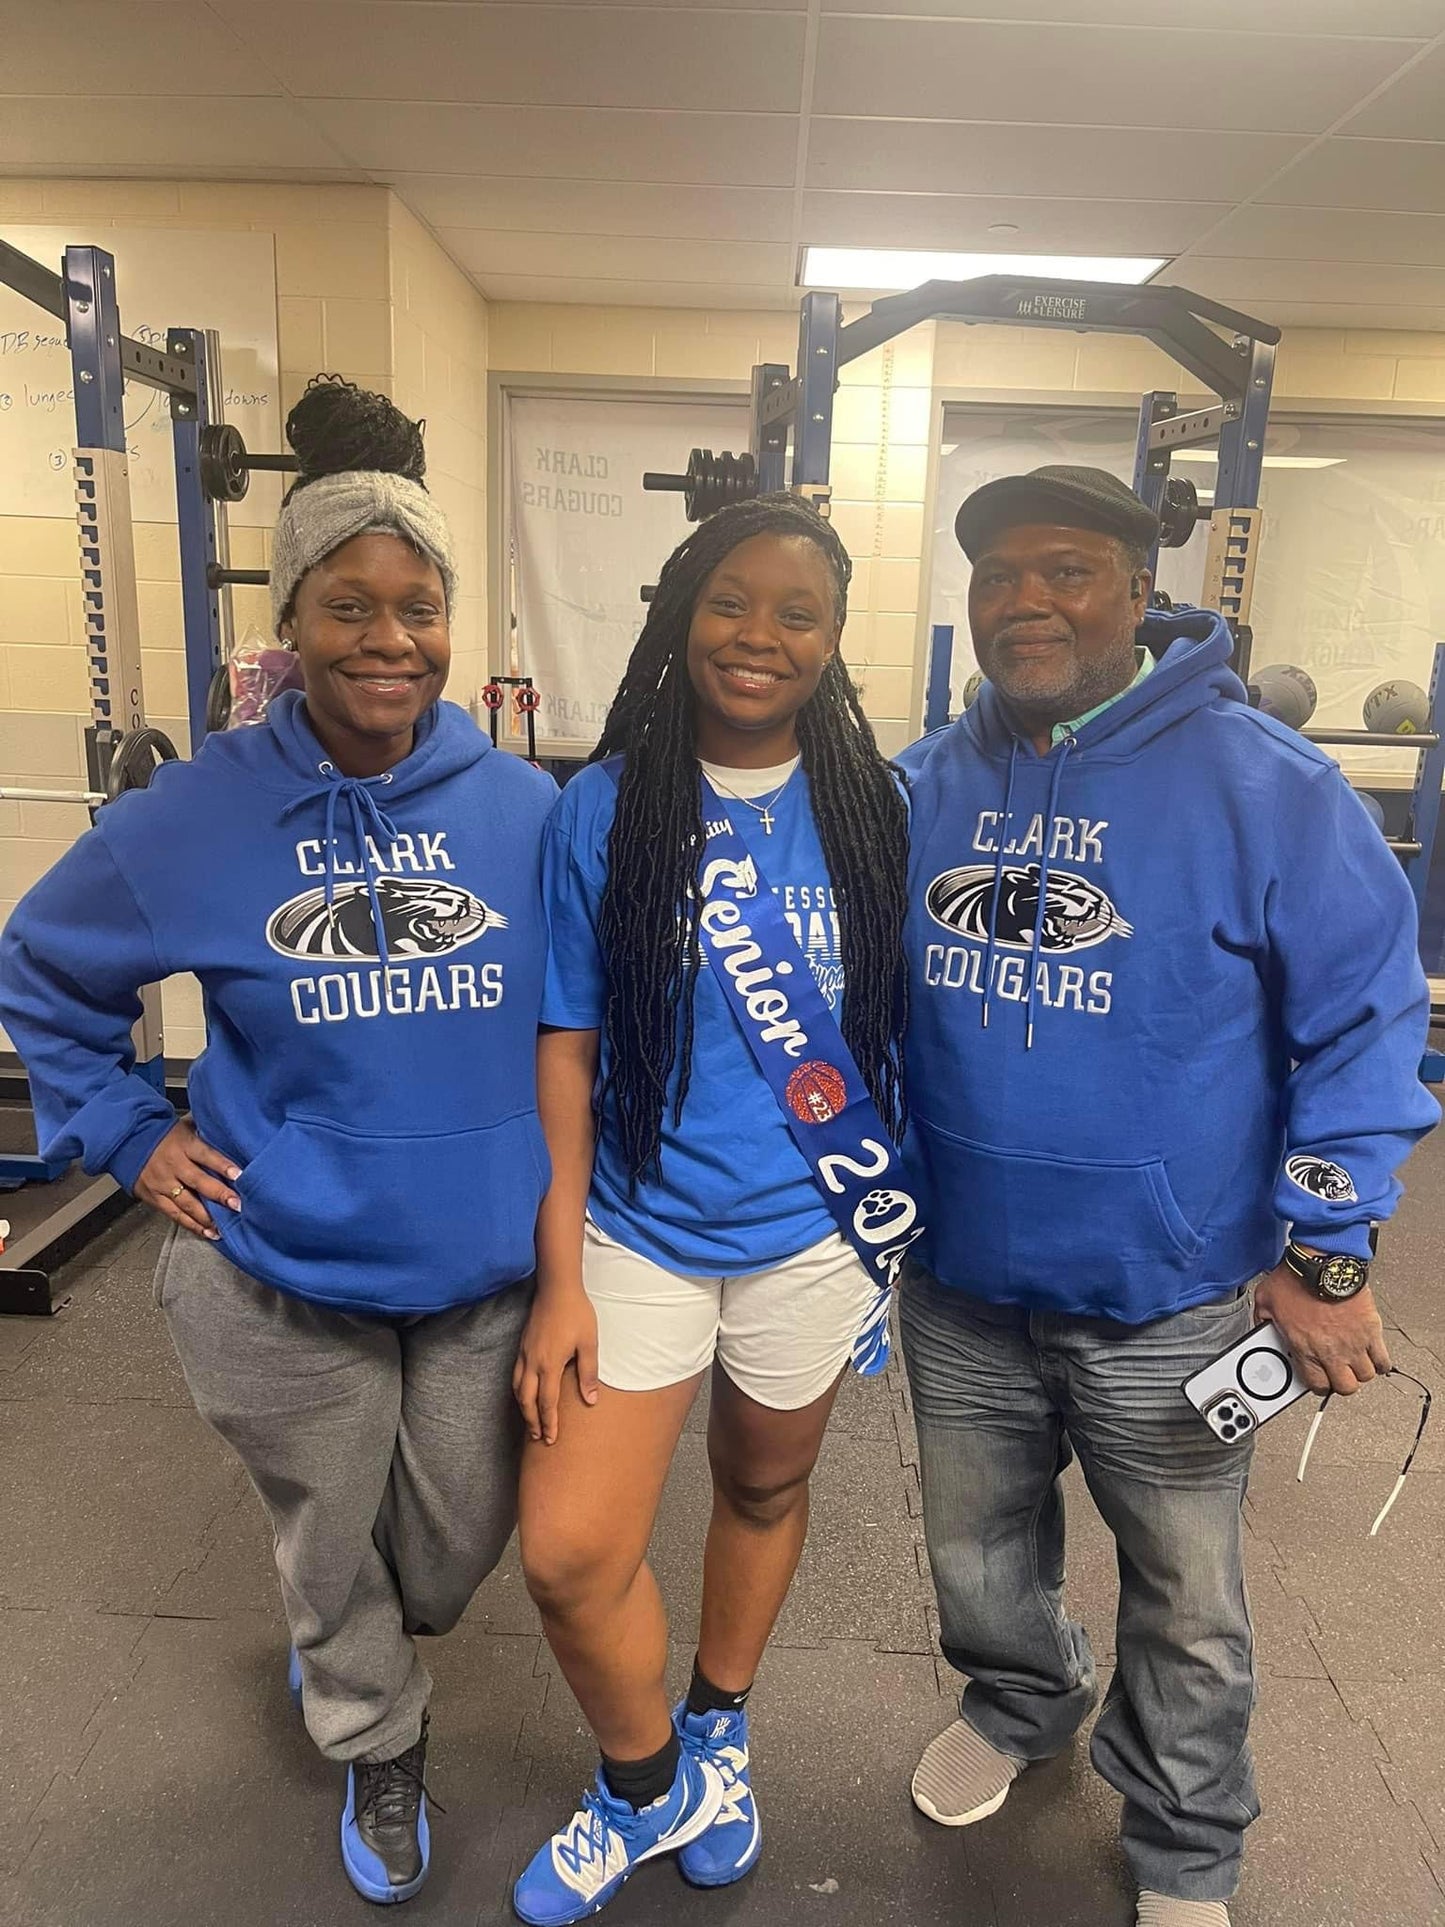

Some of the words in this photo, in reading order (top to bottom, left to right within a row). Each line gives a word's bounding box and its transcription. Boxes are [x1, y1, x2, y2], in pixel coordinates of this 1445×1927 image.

[1034, 295, 1087, 309] EXERCISE
[224, 389, 270, 406] downs
[686, 853, 808, 1058] Senior
[926, 944, 1113, 1015] COUGARS
[290, 963, 504, 1025] COUGARS
